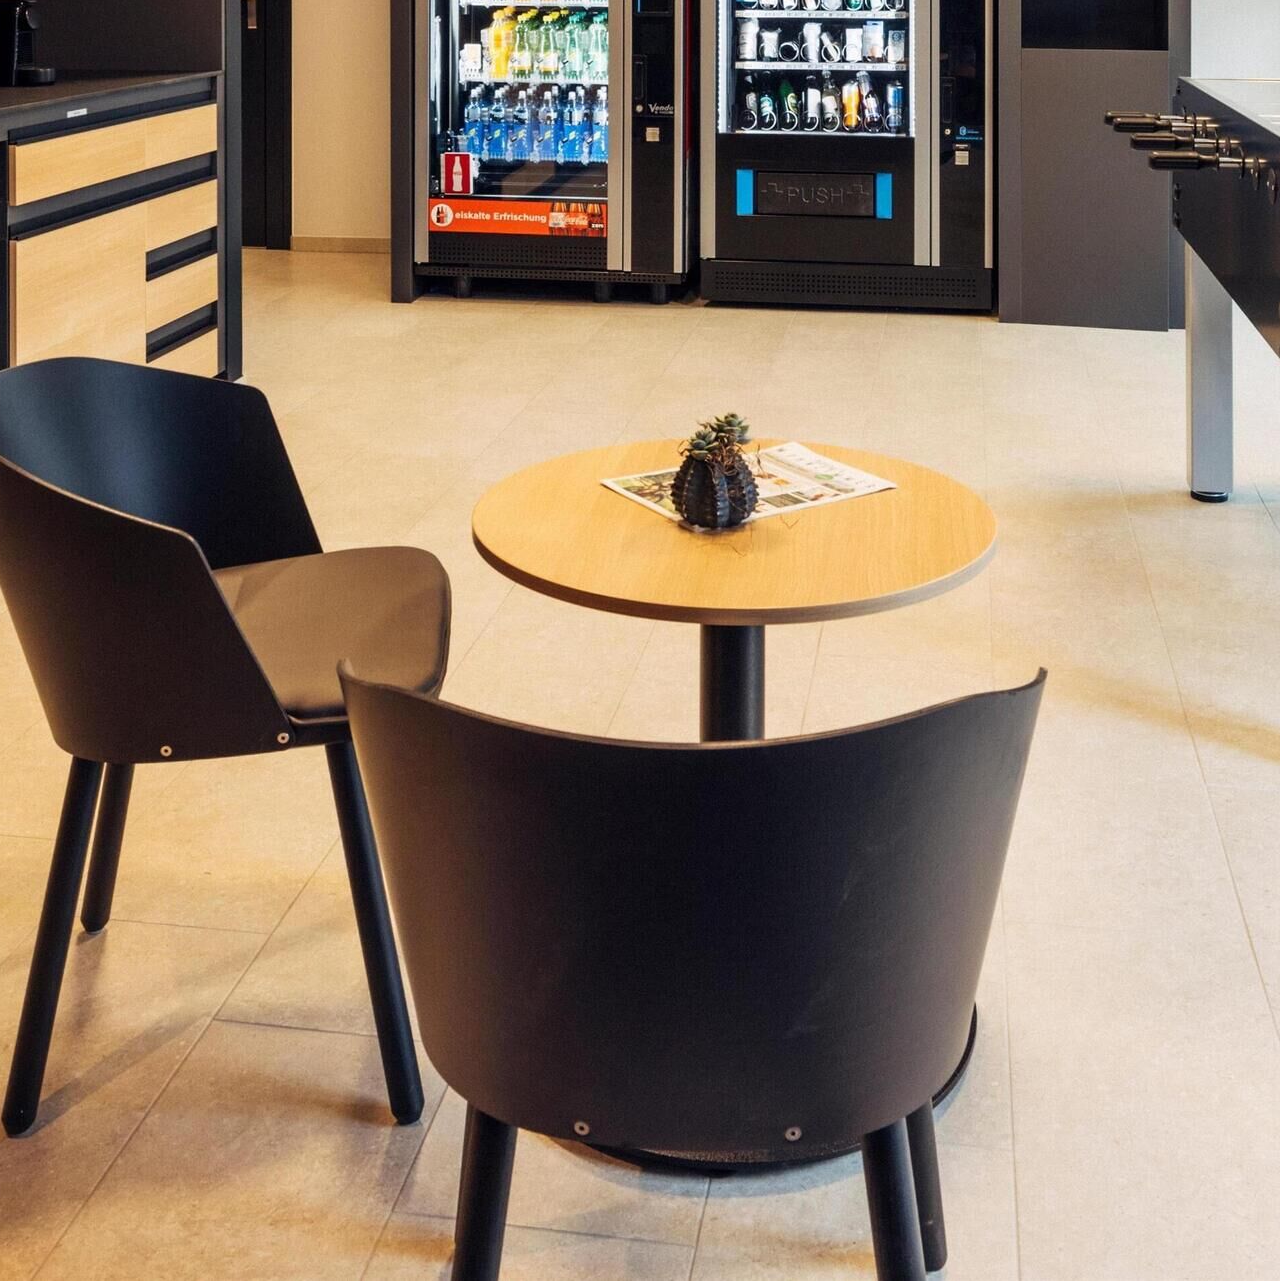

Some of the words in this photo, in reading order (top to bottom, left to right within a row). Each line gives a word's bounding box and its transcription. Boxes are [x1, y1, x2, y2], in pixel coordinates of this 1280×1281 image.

[787, 186, 844, 203] PUSH
[455, 211, 491, 220] eiskalte
[493, 212, 547, 223] Erfrischung
